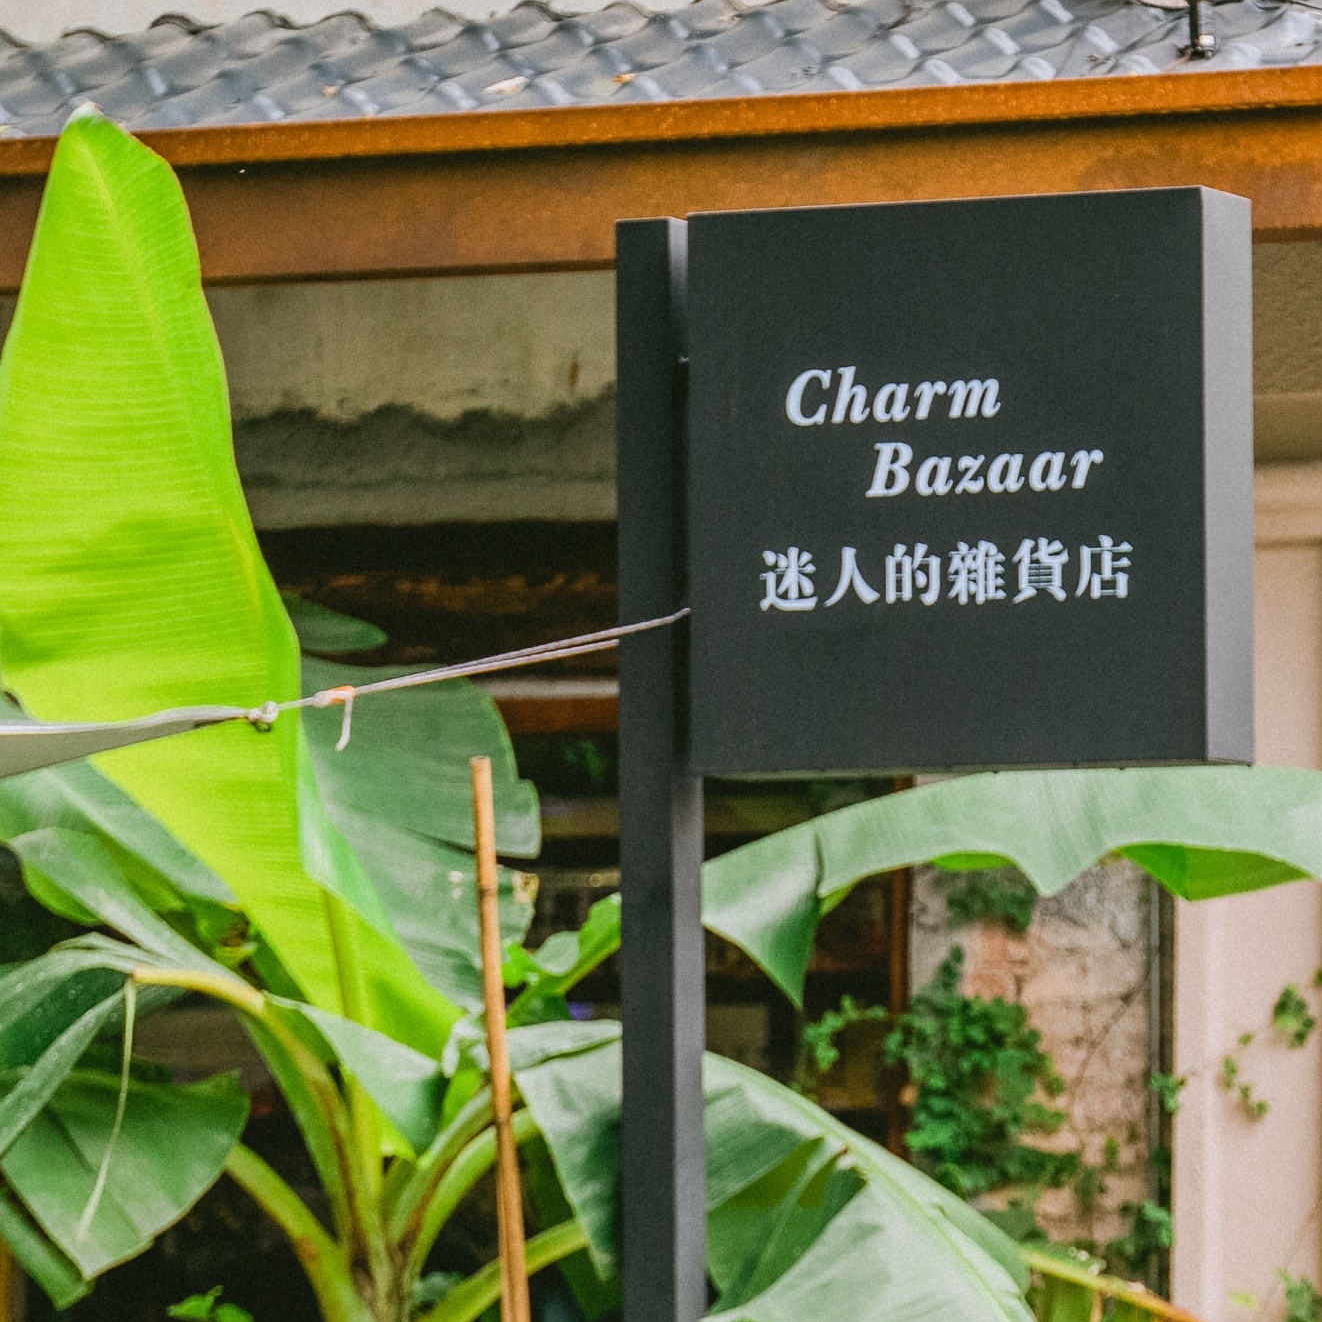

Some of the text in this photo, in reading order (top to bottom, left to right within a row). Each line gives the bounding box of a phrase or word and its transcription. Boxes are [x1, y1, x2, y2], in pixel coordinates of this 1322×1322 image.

[785, 365, 1001, 427] Charm
[865, 441, 1104, 498] Bazaar
[759, 534, 1133, 611] 迷人的雜貨店
